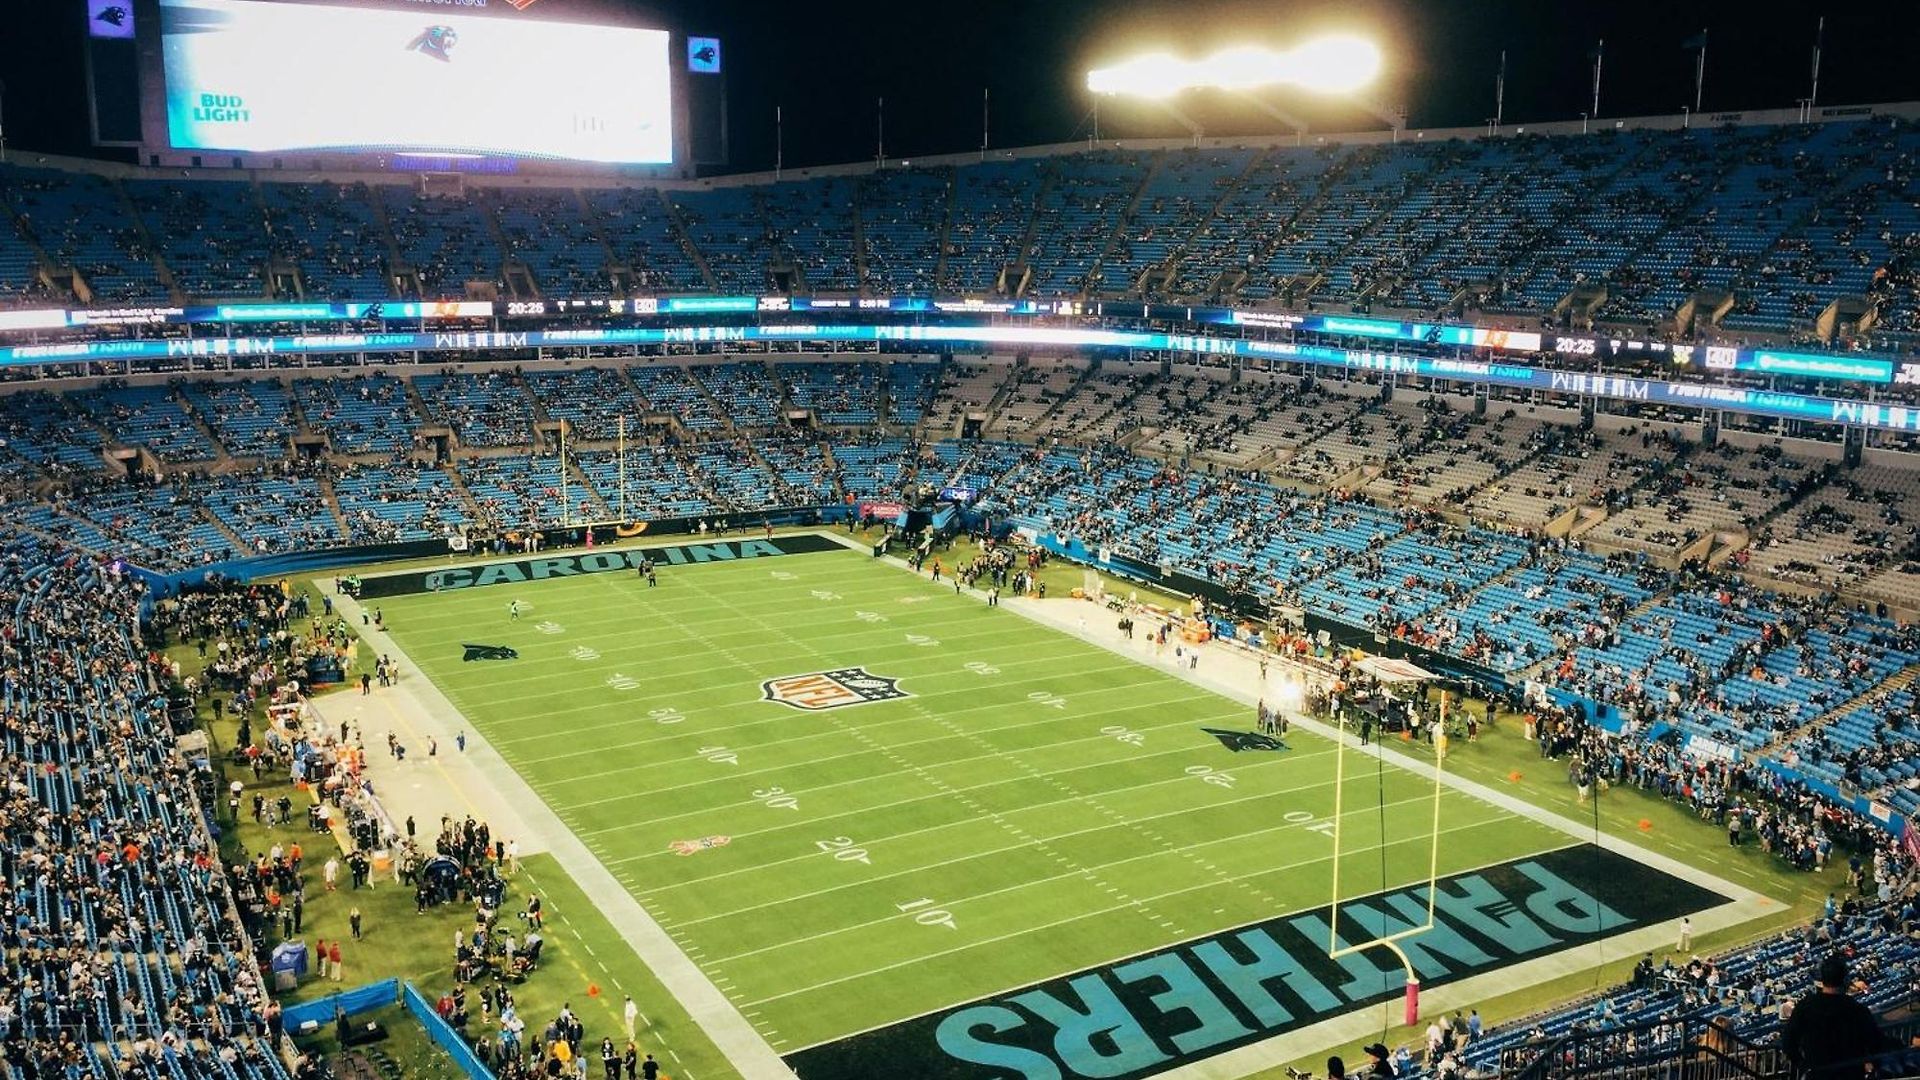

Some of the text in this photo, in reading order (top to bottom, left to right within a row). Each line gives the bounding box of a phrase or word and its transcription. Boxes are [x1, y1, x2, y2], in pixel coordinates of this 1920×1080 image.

[201, 93, 242, 107] BUD
[194, 107, 250, 122] LIGHT
[1556, 337, 1595, 355] 20:25
[426, 539, 786, 590] CAROLINA
[775, 676, 855, 707] NFL
[752, 787, 797, 807] 30
[815, 836, 868, 861] 20
[896, 898, 952, 925] 10
[936, 861, 1637, 1080] PANTHERS
